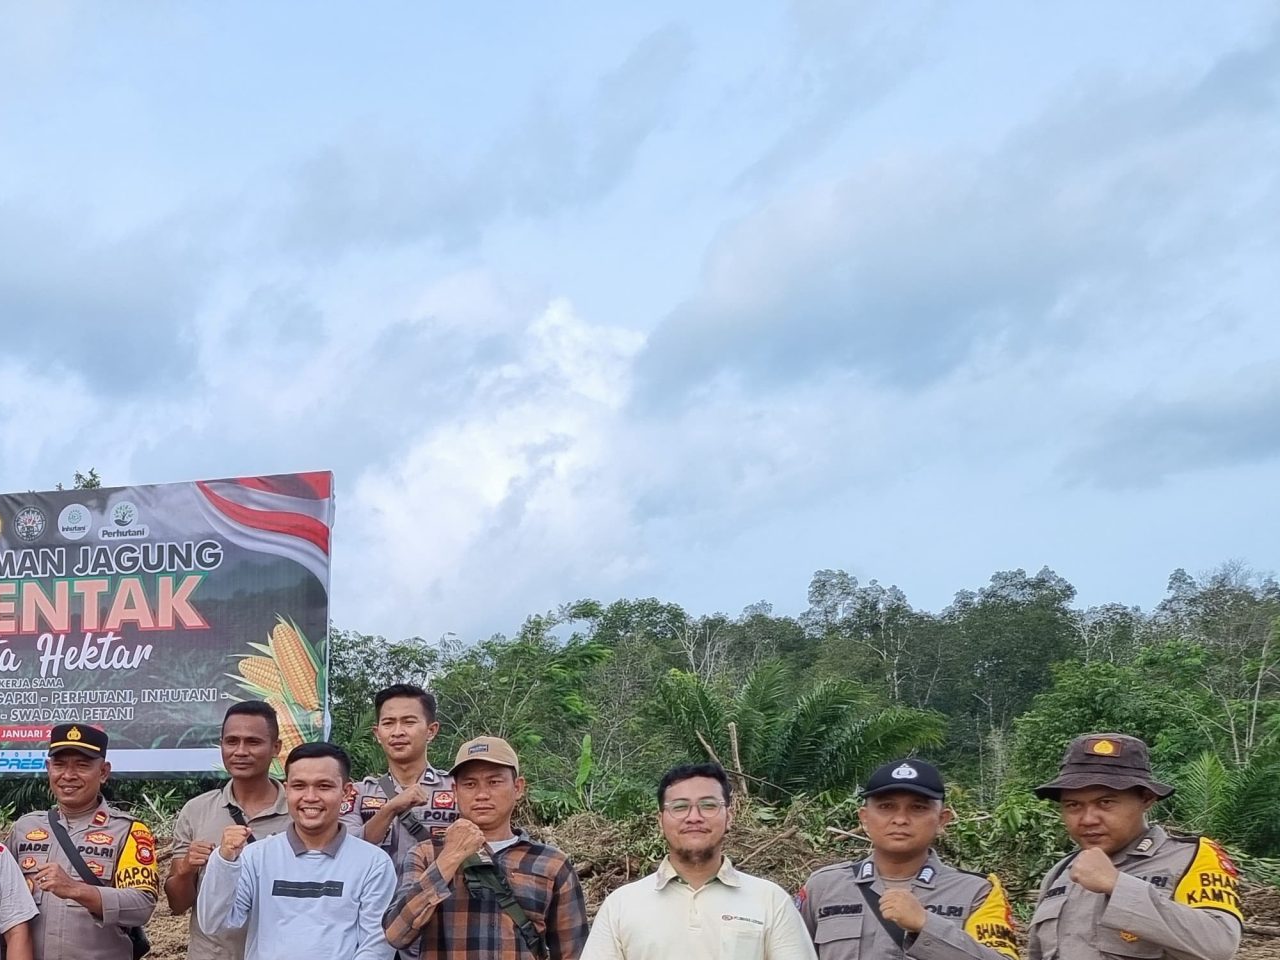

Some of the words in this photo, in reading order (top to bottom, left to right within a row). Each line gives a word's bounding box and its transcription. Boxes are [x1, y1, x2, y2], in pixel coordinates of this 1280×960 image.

[102, 528, 145, 538] Perhutani
[73, 540, 223, 576] JAGUNG
[36, 631, 153, 678] Hektar
[33, 676, 64, 689] SAMA
[51, 689, 137, 705] PERHUTANI,
[141, 688, 217, 702] INHUTANI
[10, 708, 79, 722] SWADAYA
[82, 706, 134, 721] PETANI
[1, 729, 43, 738] JANUARI
[46, 729, 52, 738] 2
[78, 845, 114, 858] POLRI
[924, 904, 964, 917] OLRI
